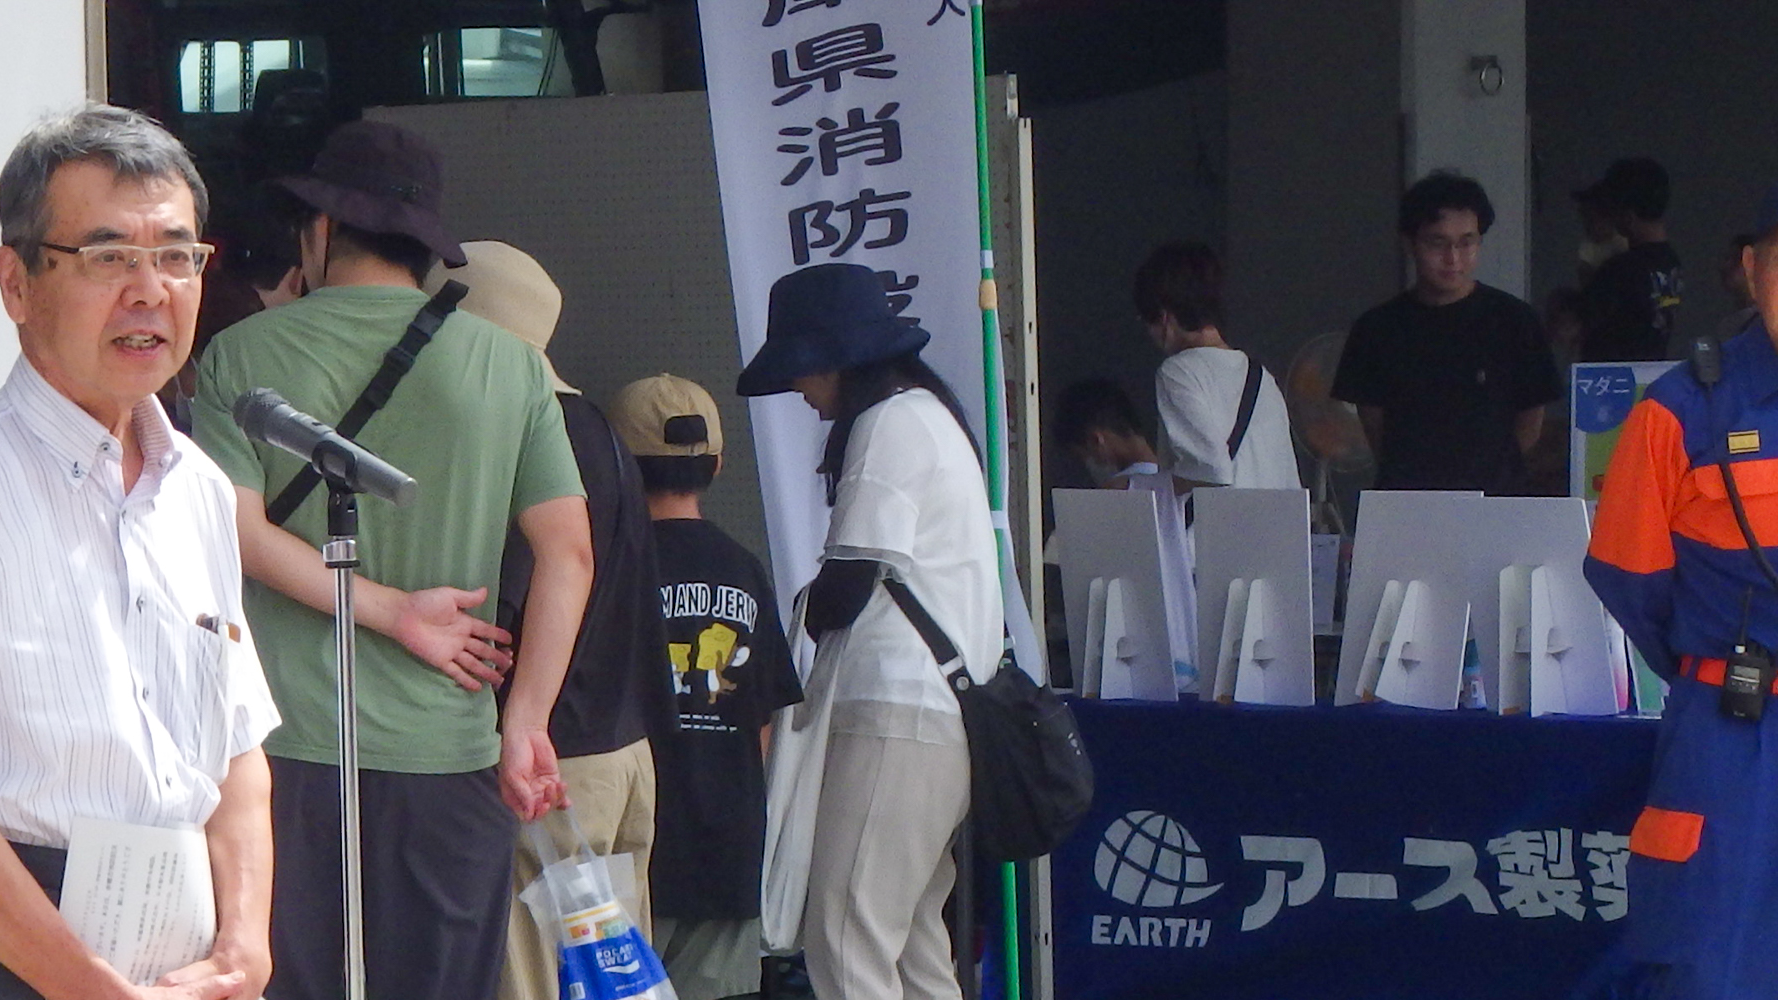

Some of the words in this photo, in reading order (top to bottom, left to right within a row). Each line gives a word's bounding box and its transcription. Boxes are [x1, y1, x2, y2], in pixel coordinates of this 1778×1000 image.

[762, 0, 920, 327] 県消防
[1577, 375, 1630, 396] マダニ
[674, 582, 711, 618] AND
[1091, 915, 1212, 947] EARTH
